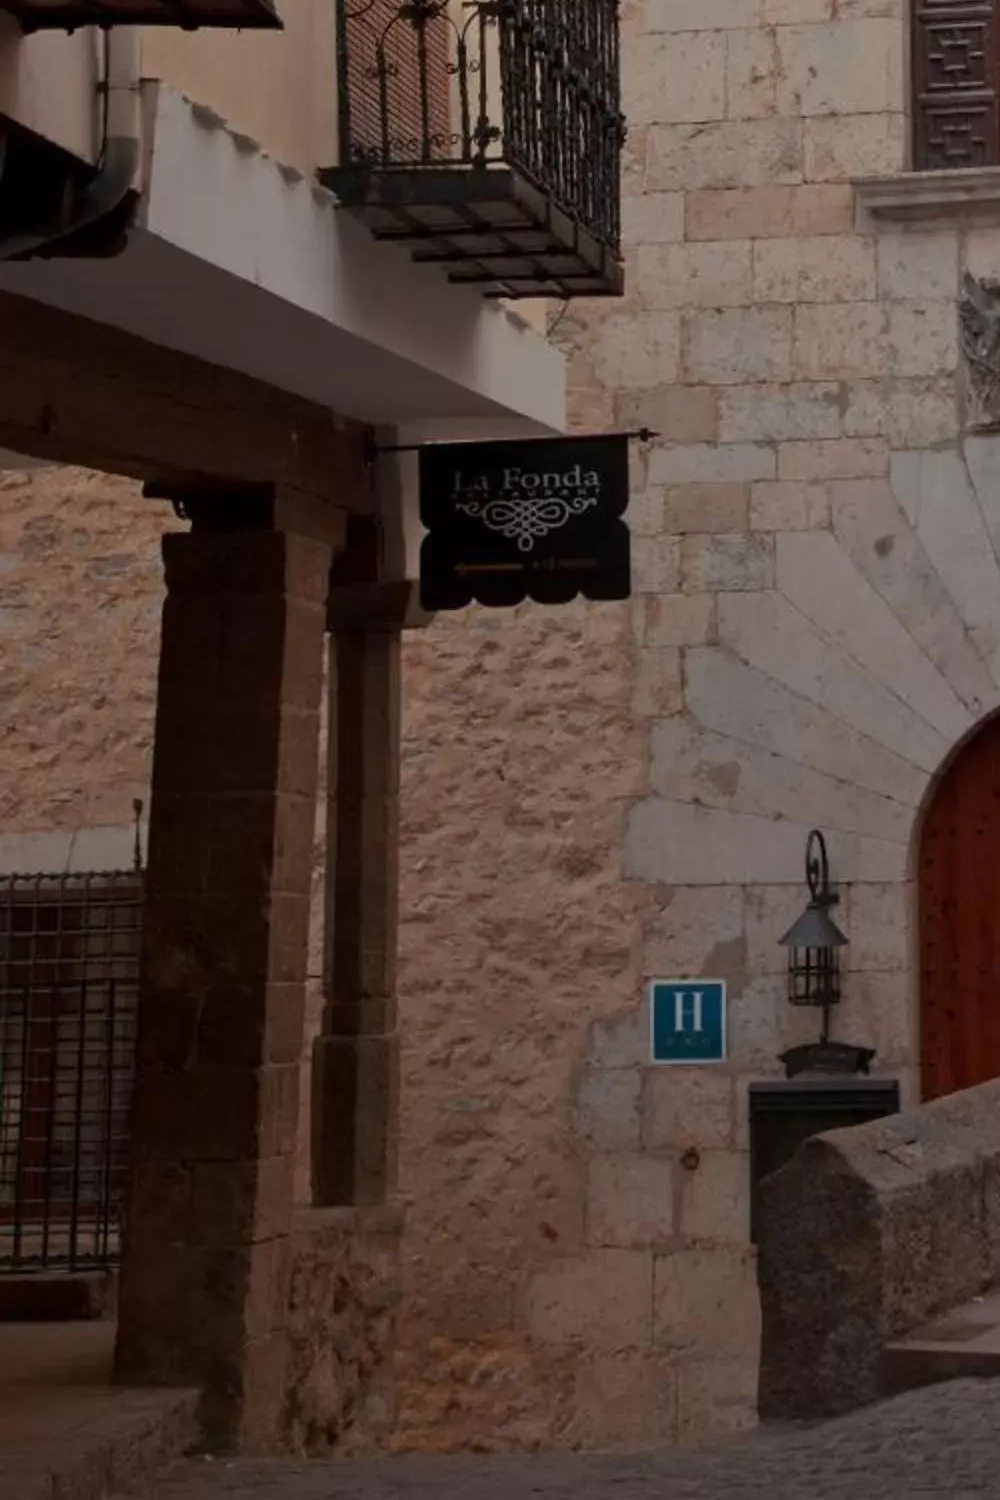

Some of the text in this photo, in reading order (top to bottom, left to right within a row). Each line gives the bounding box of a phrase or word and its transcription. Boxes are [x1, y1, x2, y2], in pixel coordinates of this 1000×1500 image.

[453, 464, 600, 492] La Fonda
[672, 991, 705, 1032] H
